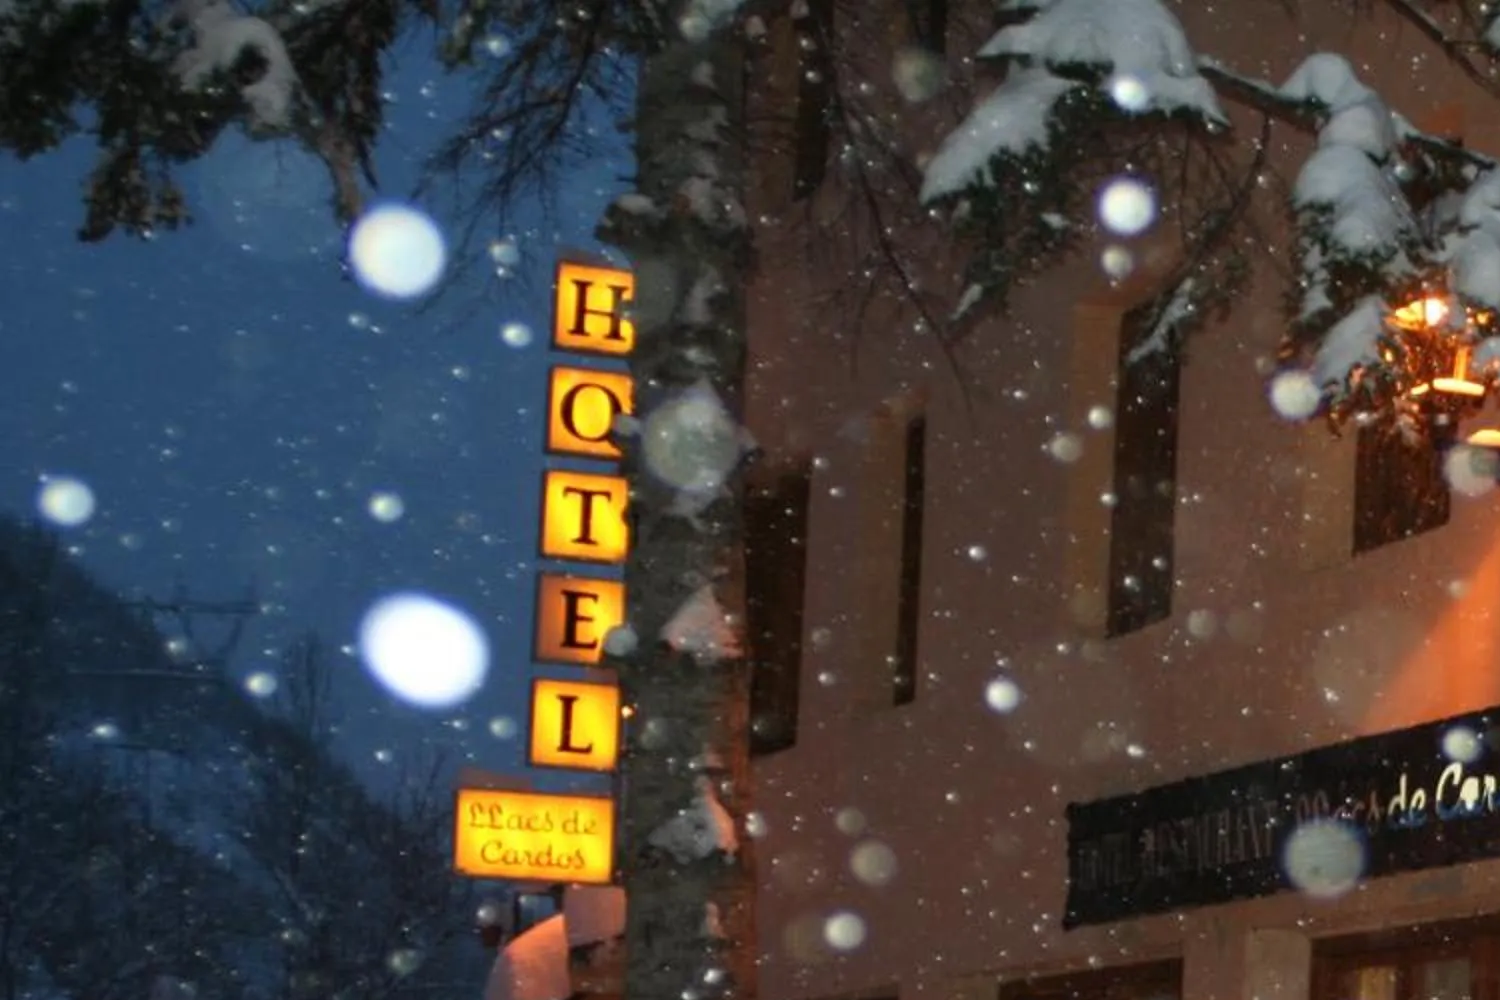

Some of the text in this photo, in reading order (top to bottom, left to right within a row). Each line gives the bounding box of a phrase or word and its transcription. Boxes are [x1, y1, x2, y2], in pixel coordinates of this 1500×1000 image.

[556, 279, 627, 754] HOTEL
[561, 809, 598, 835] de
[1386, 772, 1428, 830] de
[480, 839, 587, 870] Cardos
